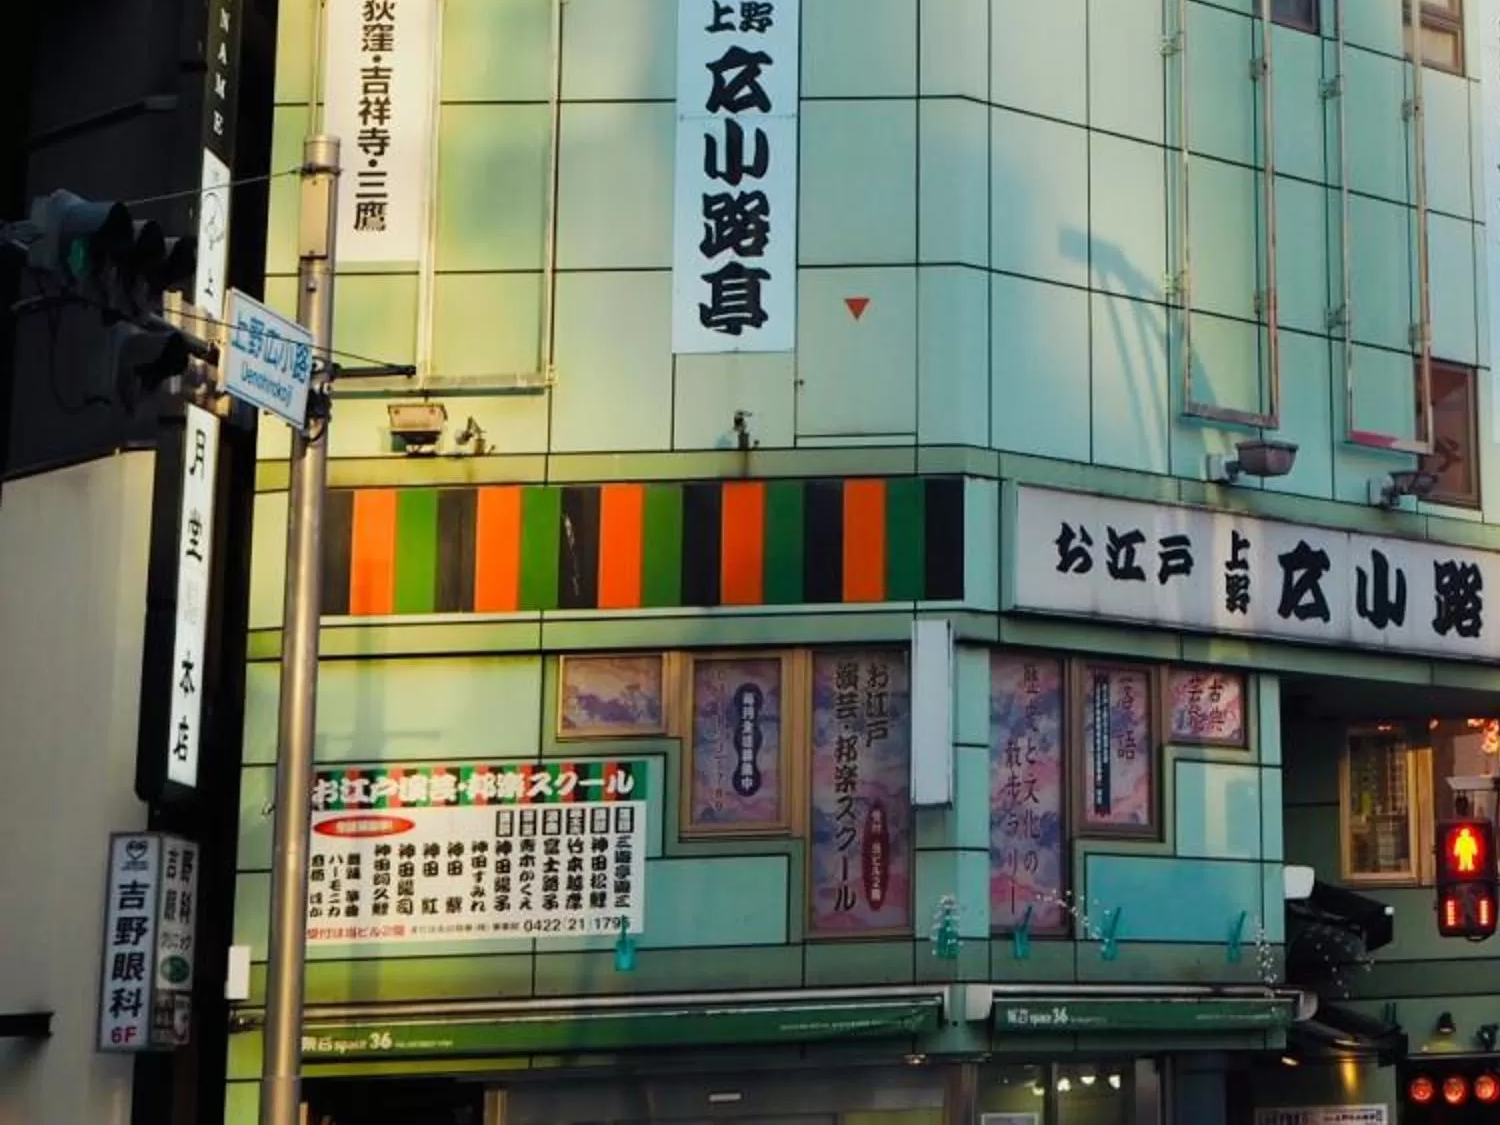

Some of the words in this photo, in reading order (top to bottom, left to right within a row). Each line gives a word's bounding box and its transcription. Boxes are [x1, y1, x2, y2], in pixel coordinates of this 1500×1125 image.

[703, 0, 776, 37] 上野
[697, 42, 773, 338] 広小路亭
[231, 310, 310, 384] 上野広小路
[1054, 521, 1194, 586] お江戸
[1224, 528, 1252, 616] 上野
[865, 662, 890, 748] お江戸
[832, 662, 859, 913] 演芸・邦楽スクール
[108, 879, 150, 1019] 吉野眼科
[110, 1026, 137, 1044] 6F
[368, 1030, 393, 1052] 36
